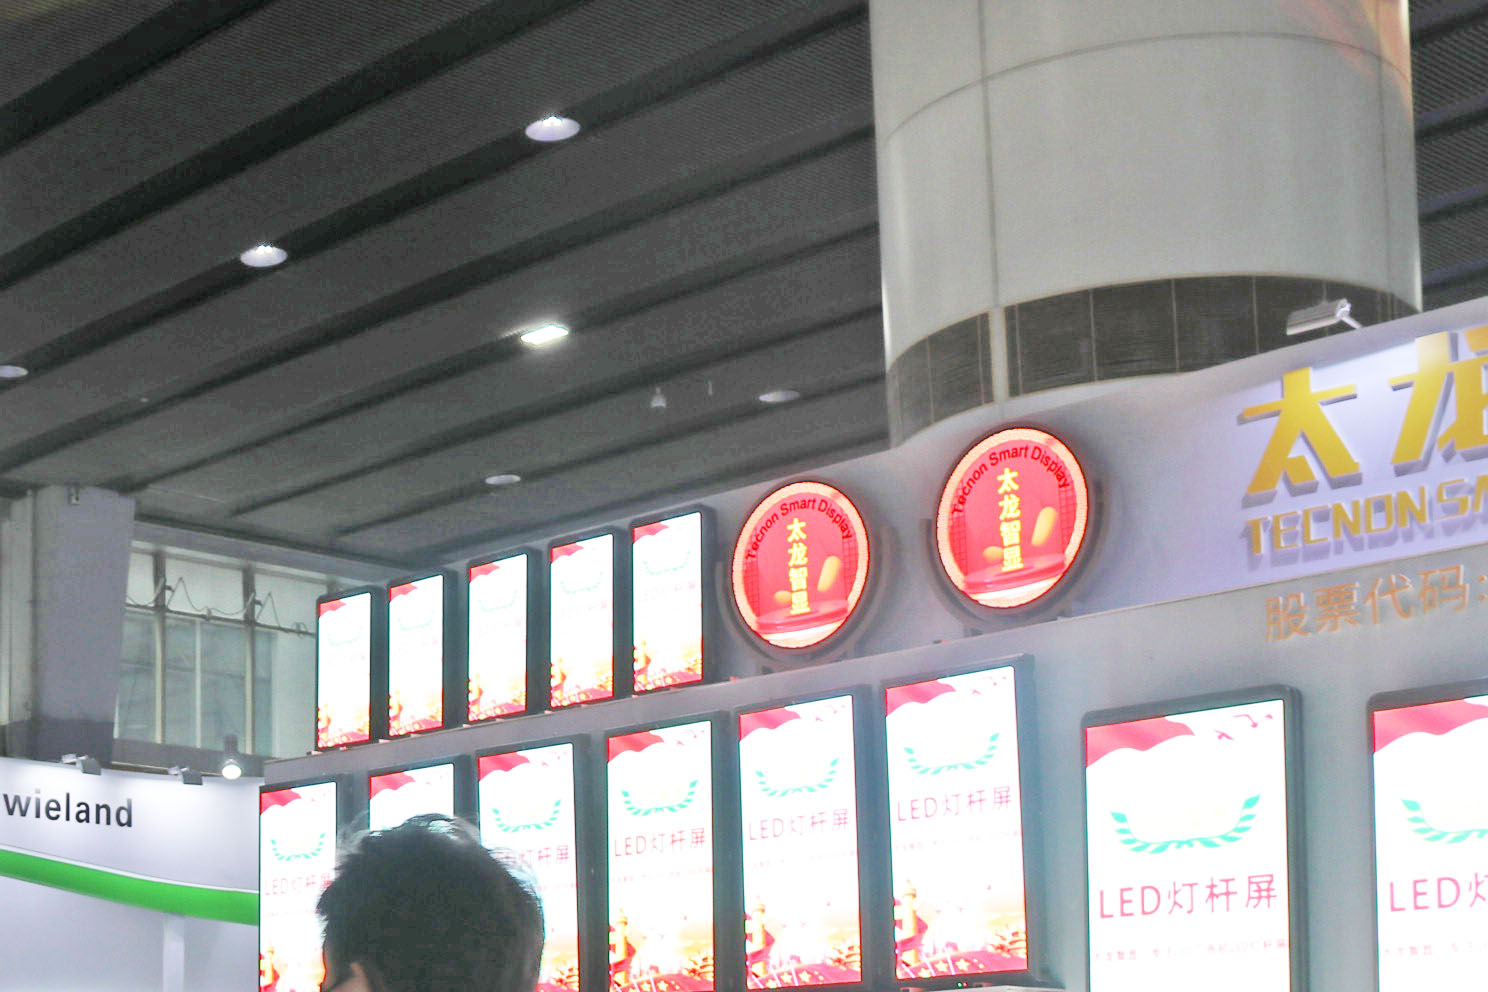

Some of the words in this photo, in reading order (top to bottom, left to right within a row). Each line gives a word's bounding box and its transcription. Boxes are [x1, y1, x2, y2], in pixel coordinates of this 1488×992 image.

[951, 461, 989, 516] Tecnon
[988, 445, 1028, 467] Smart
[1030, 446, 1071, 489] Display
[779, 498, 817, 517] Smart
[817, 499, 854, 540] Display
[996, 467, 1024, 572] 太龙智显
[1245, 486, 1427, 554] TECNON
[3, 789, 133, 828] wieland
[1099, 873, 1278, 919] LED灯杆屏
